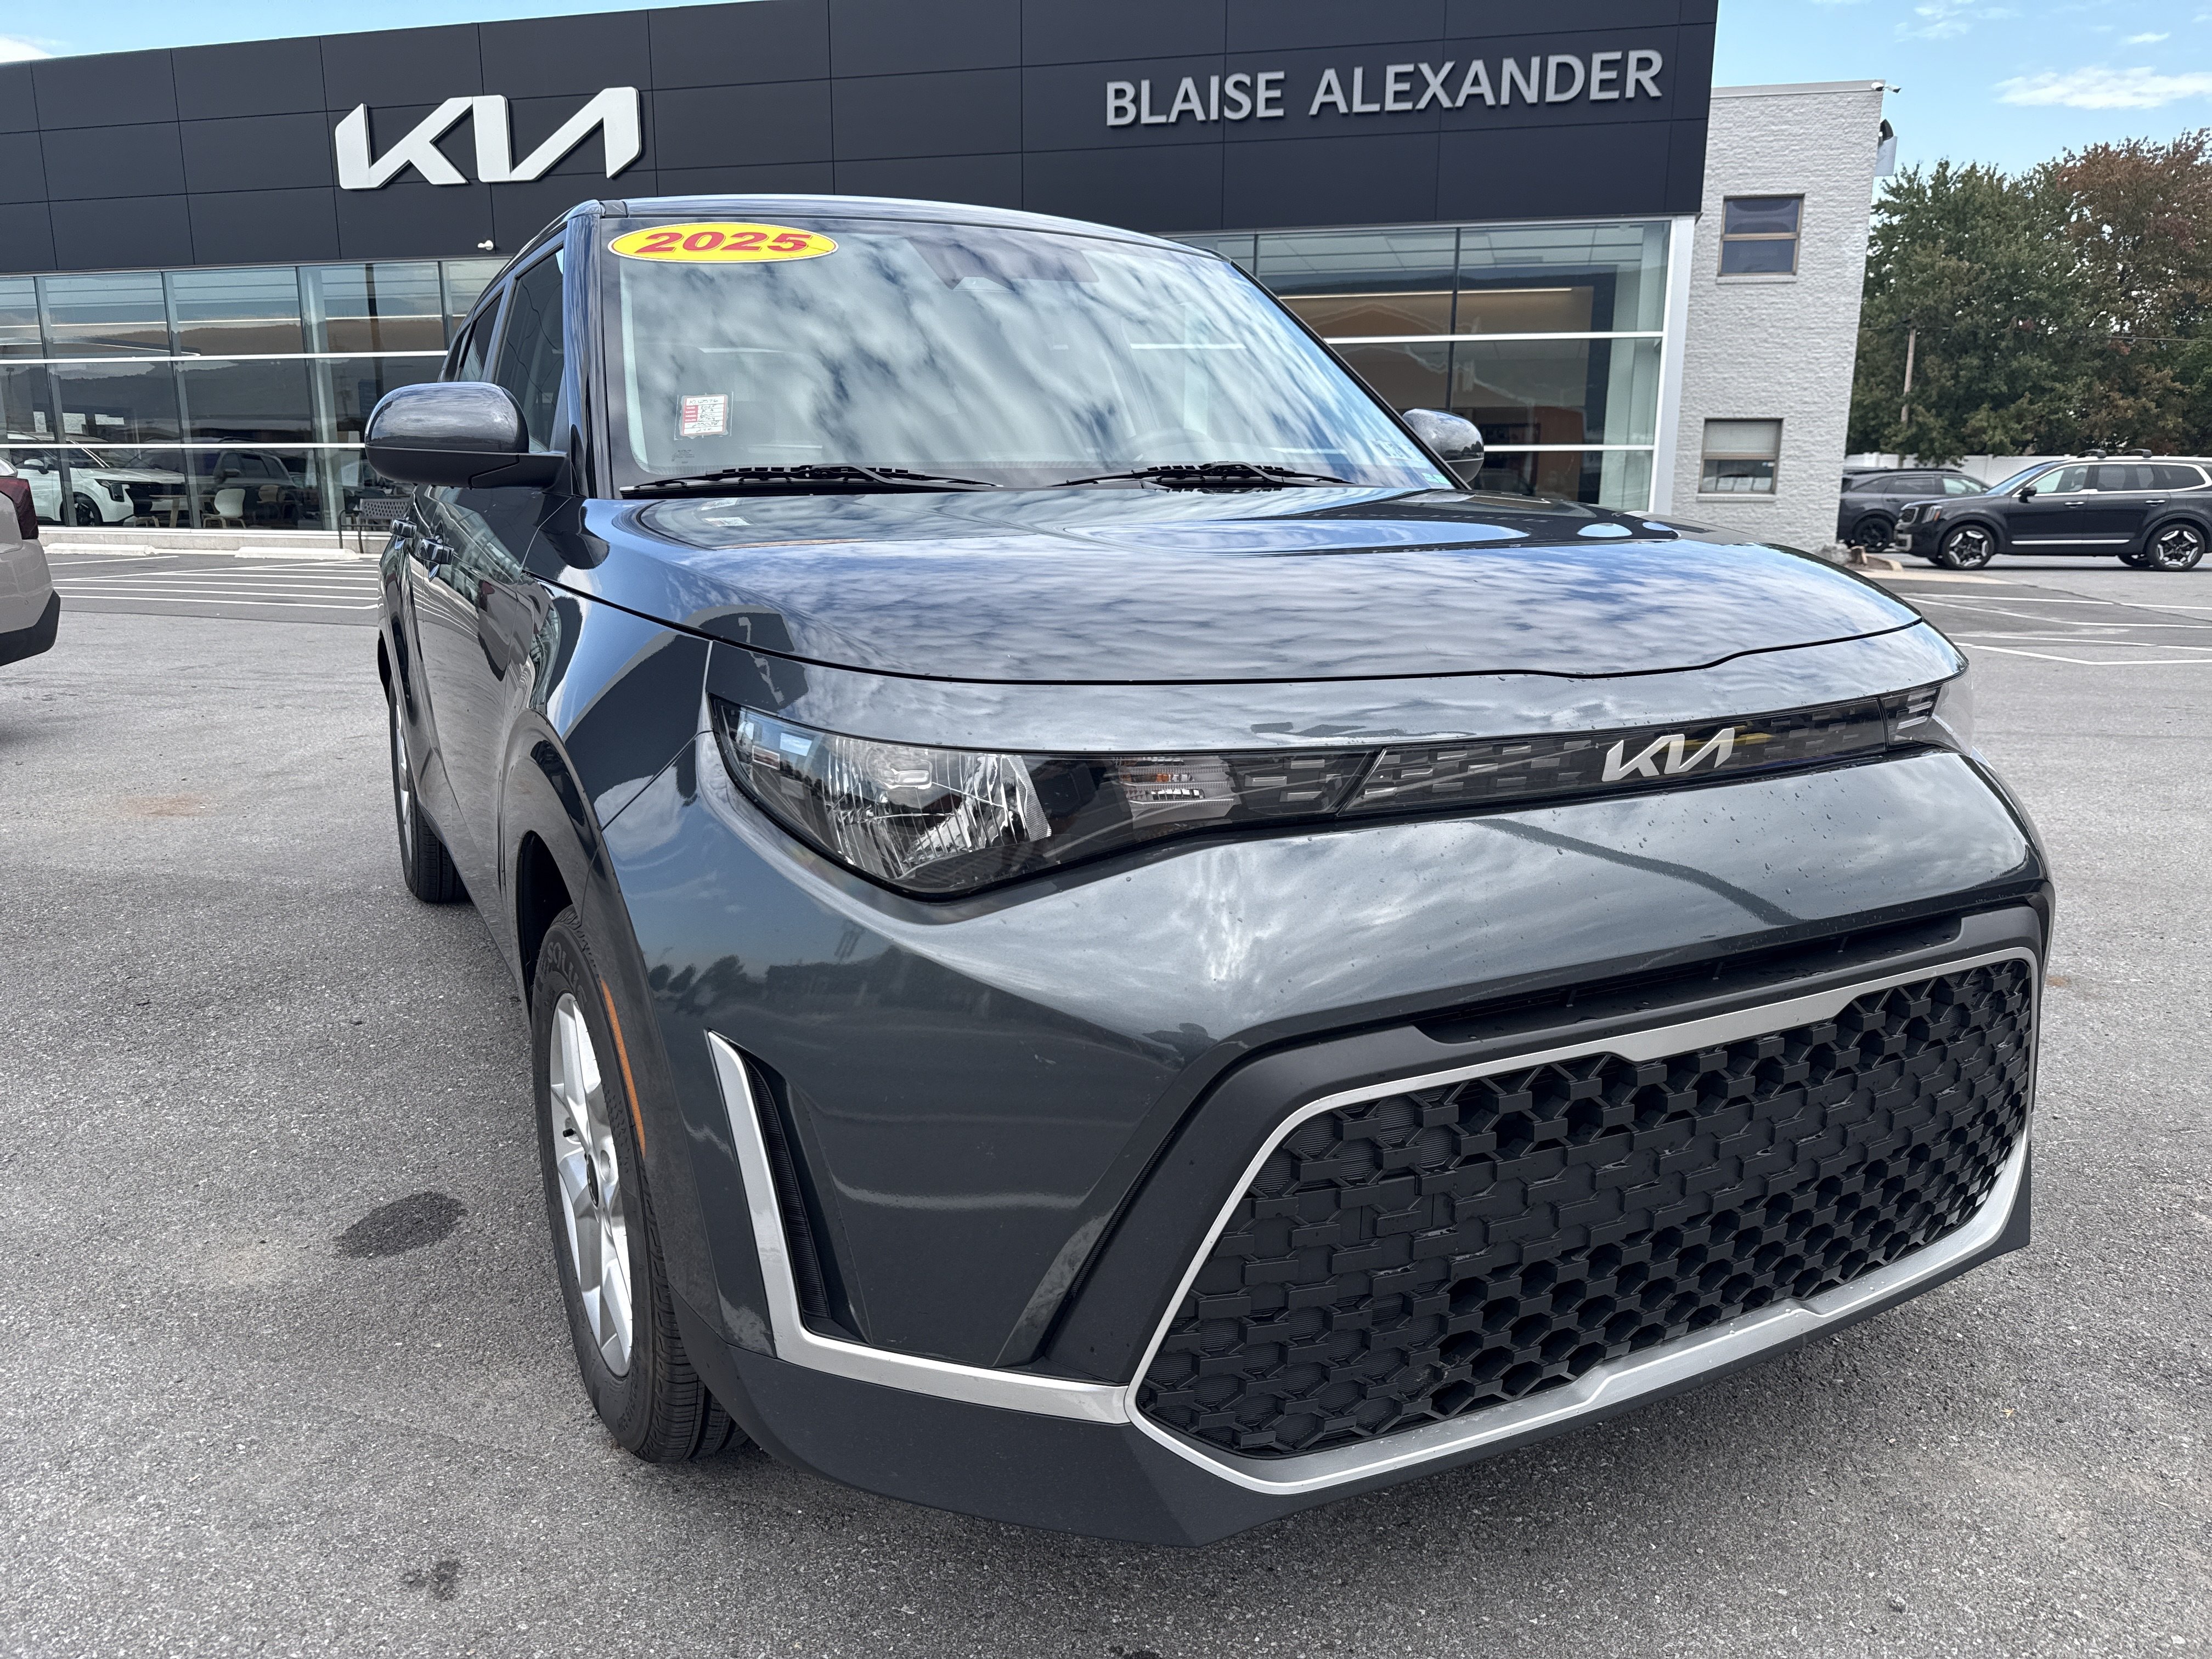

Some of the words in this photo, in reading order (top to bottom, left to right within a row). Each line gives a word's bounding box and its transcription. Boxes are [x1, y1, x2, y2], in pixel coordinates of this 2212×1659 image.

[1106, 71, 1285, 126] BLAISE
[1308, 49, 1663, 116] ALEXANDER
[335, 86, 642, 190] KIA
[634, 232, 814, 253] 2025
[1601, 727, 1735, 782] KIA
[548, 941, 588, 1015] SOLUS
